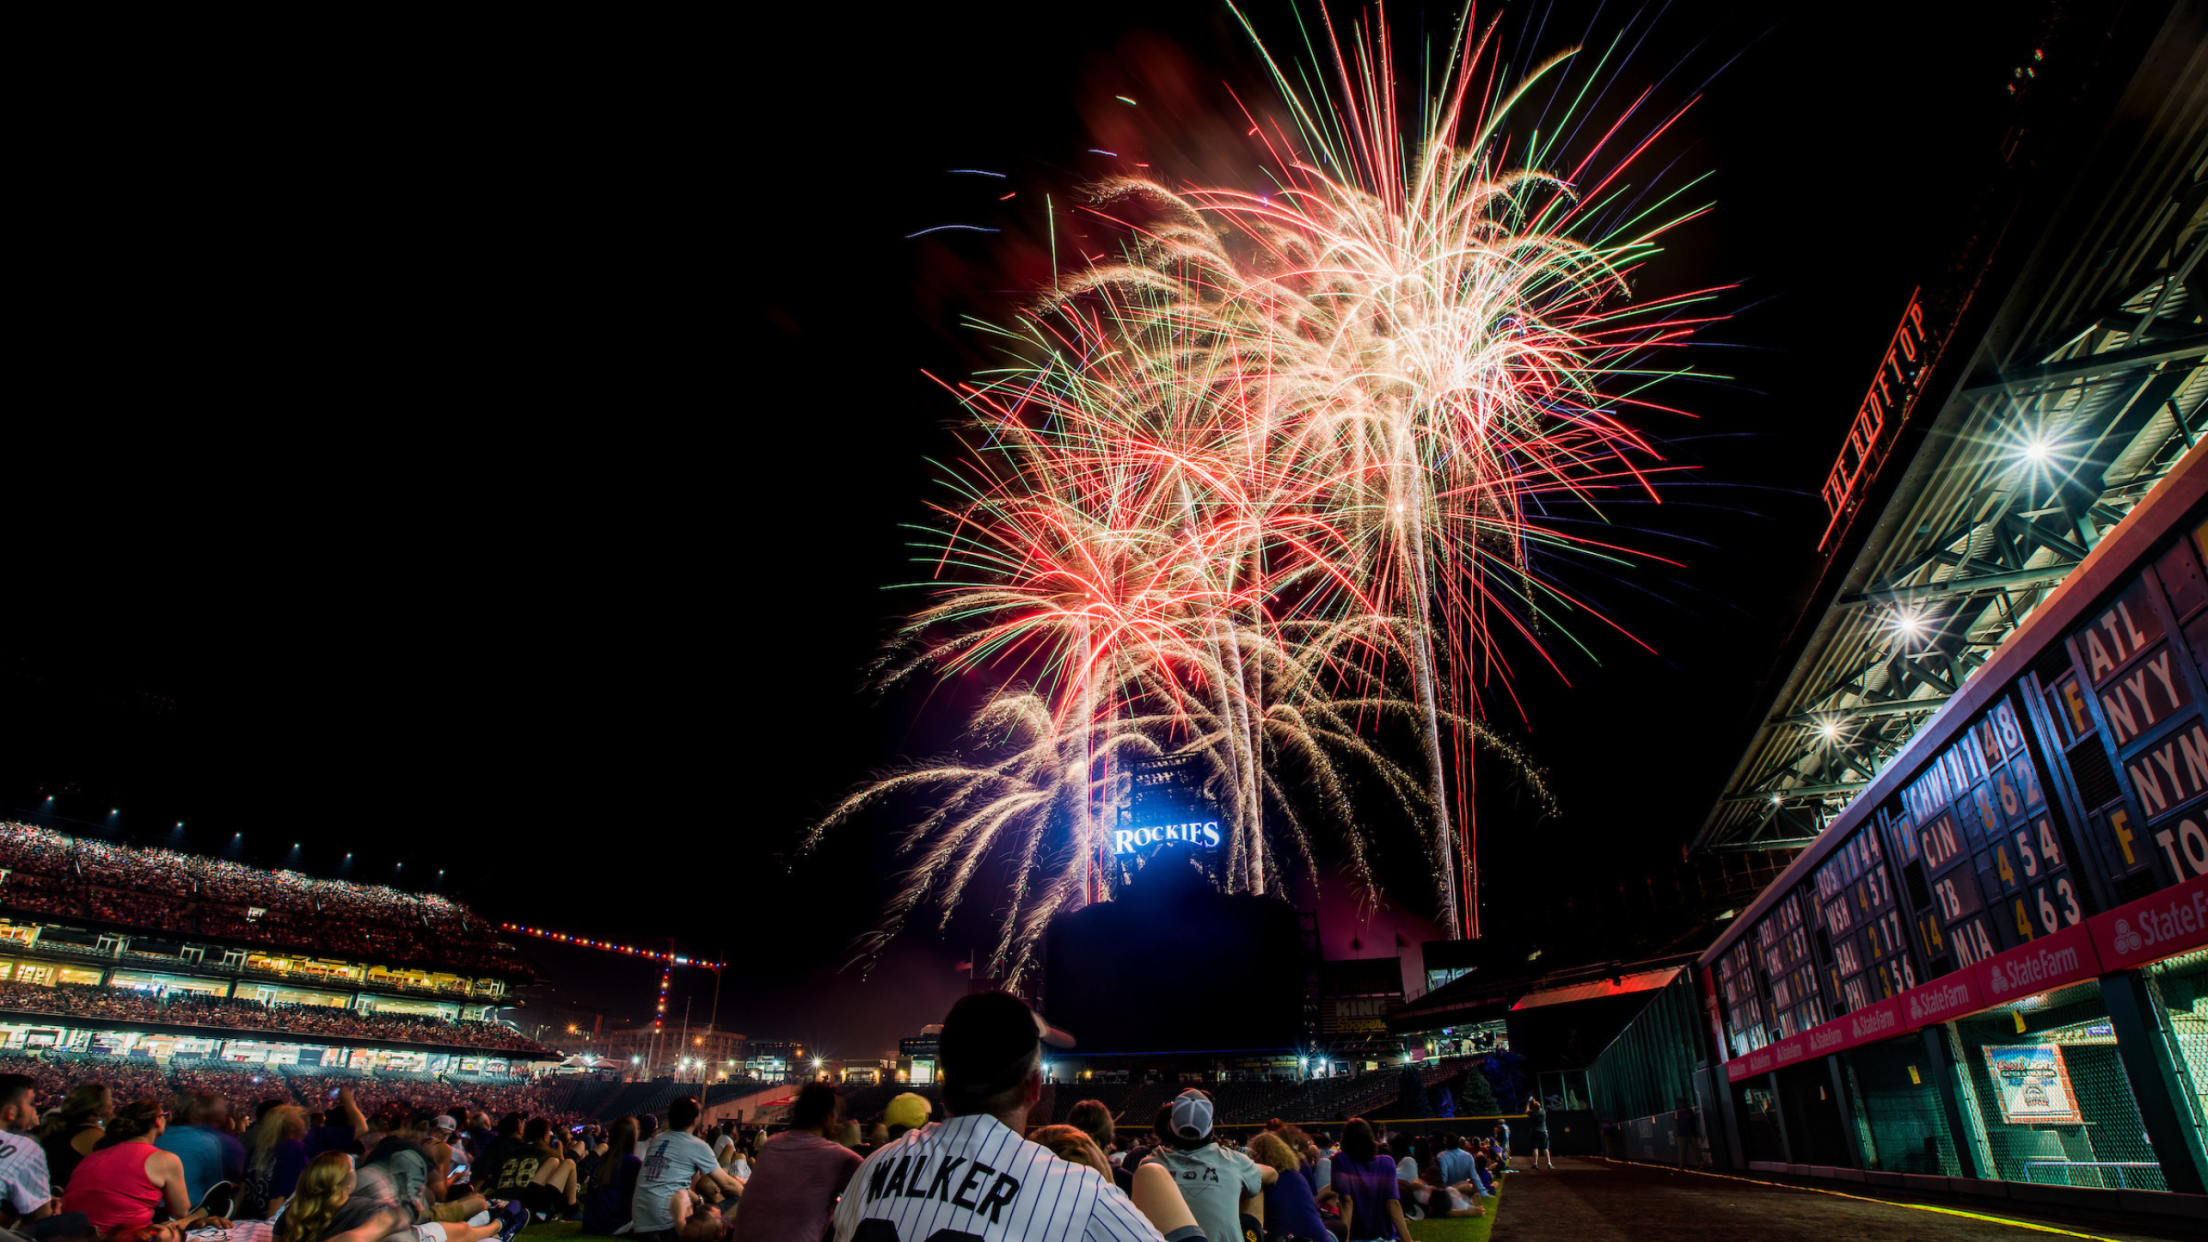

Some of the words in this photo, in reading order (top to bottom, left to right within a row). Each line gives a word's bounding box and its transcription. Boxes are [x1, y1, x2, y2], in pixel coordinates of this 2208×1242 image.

[1824, 459, 1853, 520] THE
[1852, 303, 1925, 461] ROOFTOP
[2086, 601, 2146, 682] ATL
[2063, 679, 2085, 733] F
[2102, 650, 2180, 745] NYY
[1910, 766, 1944, 822] CHW
[2129, 725, 2208, 816] NYM
[1113, 821, 1220, 855] ROCKIES
[1922, 816, 1957, 867] CIN
[1976, 786, 1995, 831] 8
[2000, 760, 2040, 816] 62
[2111, 809, 2135, 865] F
[2155, 809, 2208, 884] TO
[1817, 862, 1838, 900] BOS
[1825, 896, 1851, 935] WSH
[1858, 882, 1869, 913] 4
[1867, 864, 1889, 907] 57
[1935, 878, 1961, 921] TB
[1997, 845, 2016, 887] 4
[2016, 819, 2061, 877] 54
[1813, 895, 1822, 924] F
[1919, 915, 1944, 957] 14
[1951, 919, 1995, 969] MIA
[2015, 899, 2034, 942] 4
[2038, 878, 2081, 934] 63
[1835, 941, 1858, 976] BAL
[1868, 926, 1881, 959] 2
[1880, 911, 1901, 951] 17
[1844, 978, 1867, 1013] PHI
[1879, 966, 1892, 998] 3
[1890, 955, 1916, 994] 56
[497, 1157, 539, 1189] 28
[866, 1155, 1020, 1225] WALKER
